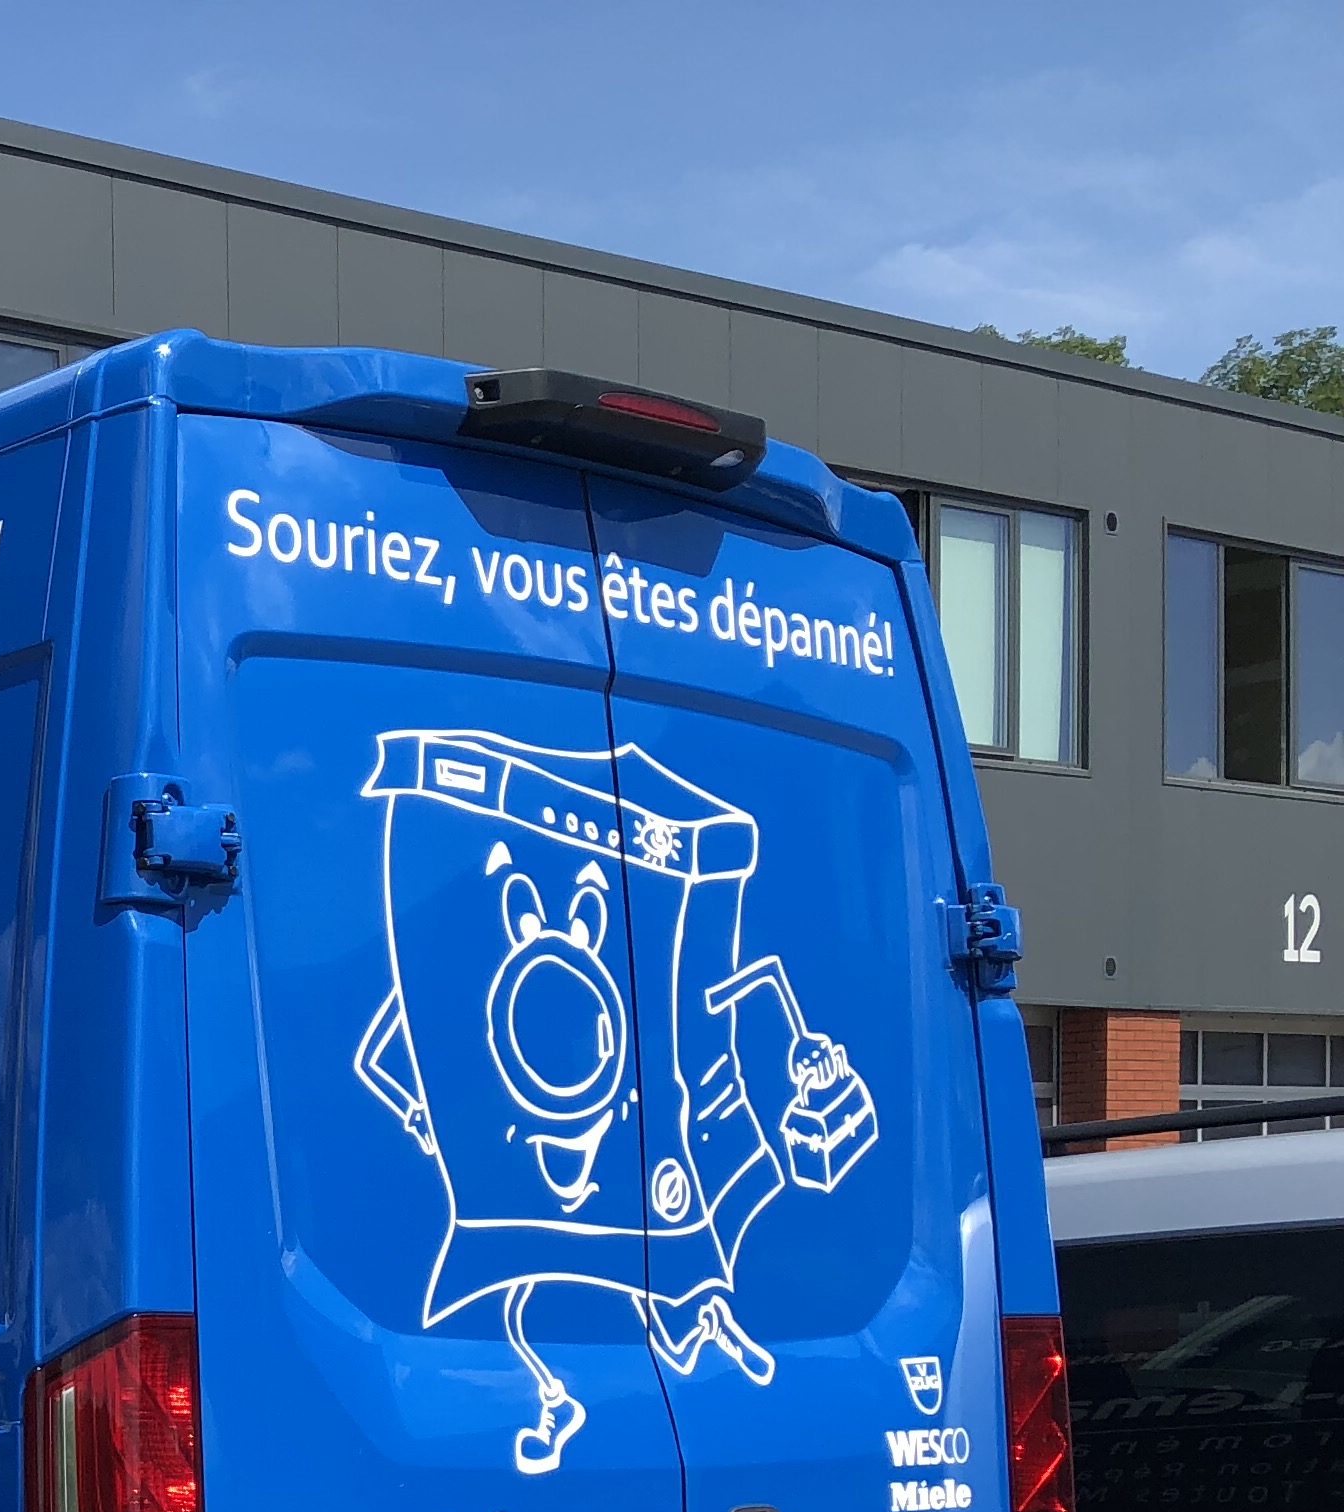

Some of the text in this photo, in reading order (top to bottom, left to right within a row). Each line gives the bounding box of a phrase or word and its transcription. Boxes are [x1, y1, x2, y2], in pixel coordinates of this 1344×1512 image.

[227, 489, 894, 677] Souriez, vous êtes dépanné!
[1283, 894, 1321, 963] 12
[910, 1374, 941, 1391] ZUG
[885, 1427, 970, 1467] WESCO
[889, 1478, 973, 1512] Miele
